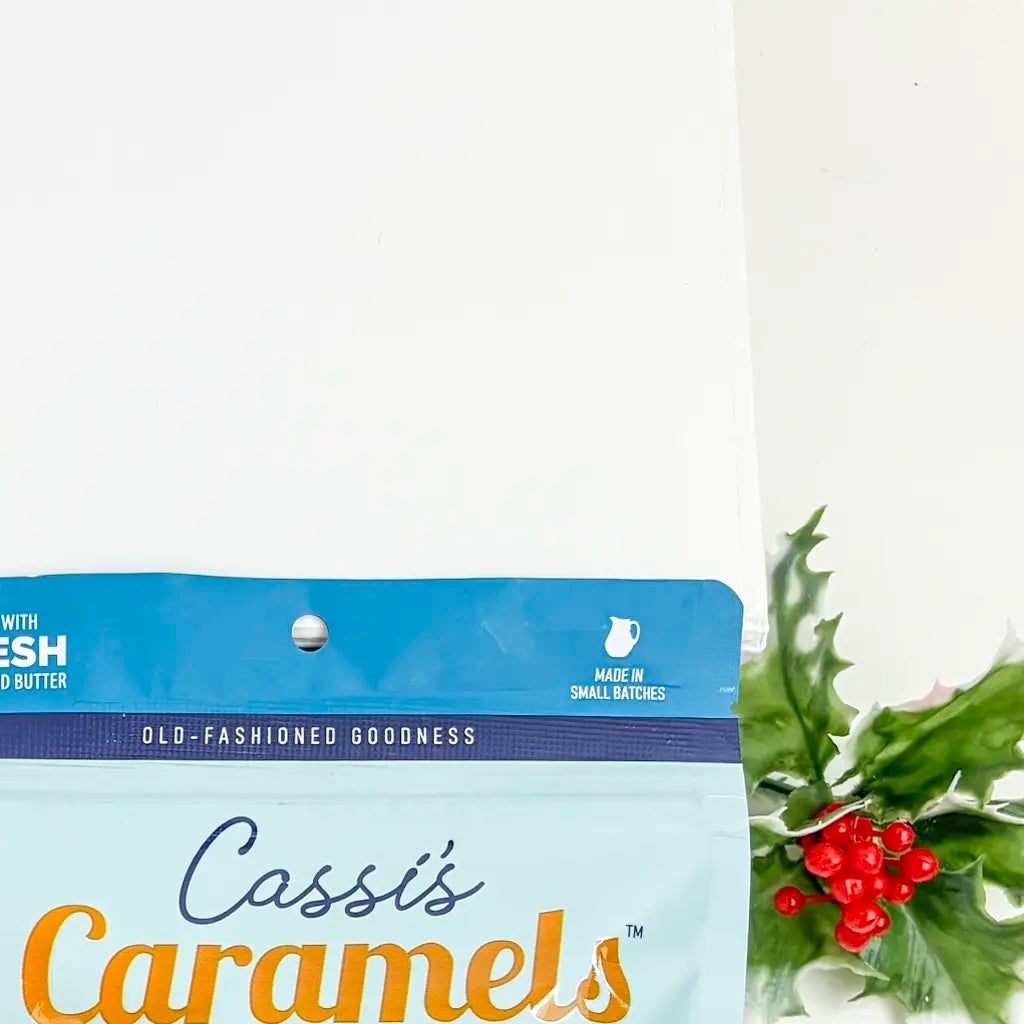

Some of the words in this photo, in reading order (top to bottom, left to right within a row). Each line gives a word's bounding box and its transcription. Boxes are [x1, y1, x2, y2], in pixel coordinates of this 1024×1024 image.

[1, 613, 38, 631] WITH
[14, 672, 67, 690] BUTTER
[594, 667, 629, 682] MADE
[631, 668, 644, 683] IN
[570, 685, 611, 700] SMALL
[613, 686, 666, 701] BATCHES
[142, 726, 336, 745] OLD-FASHIONED
[351, 727, 475, 745] GOODNESS
[178, 815, 485, 925] Cassi's
